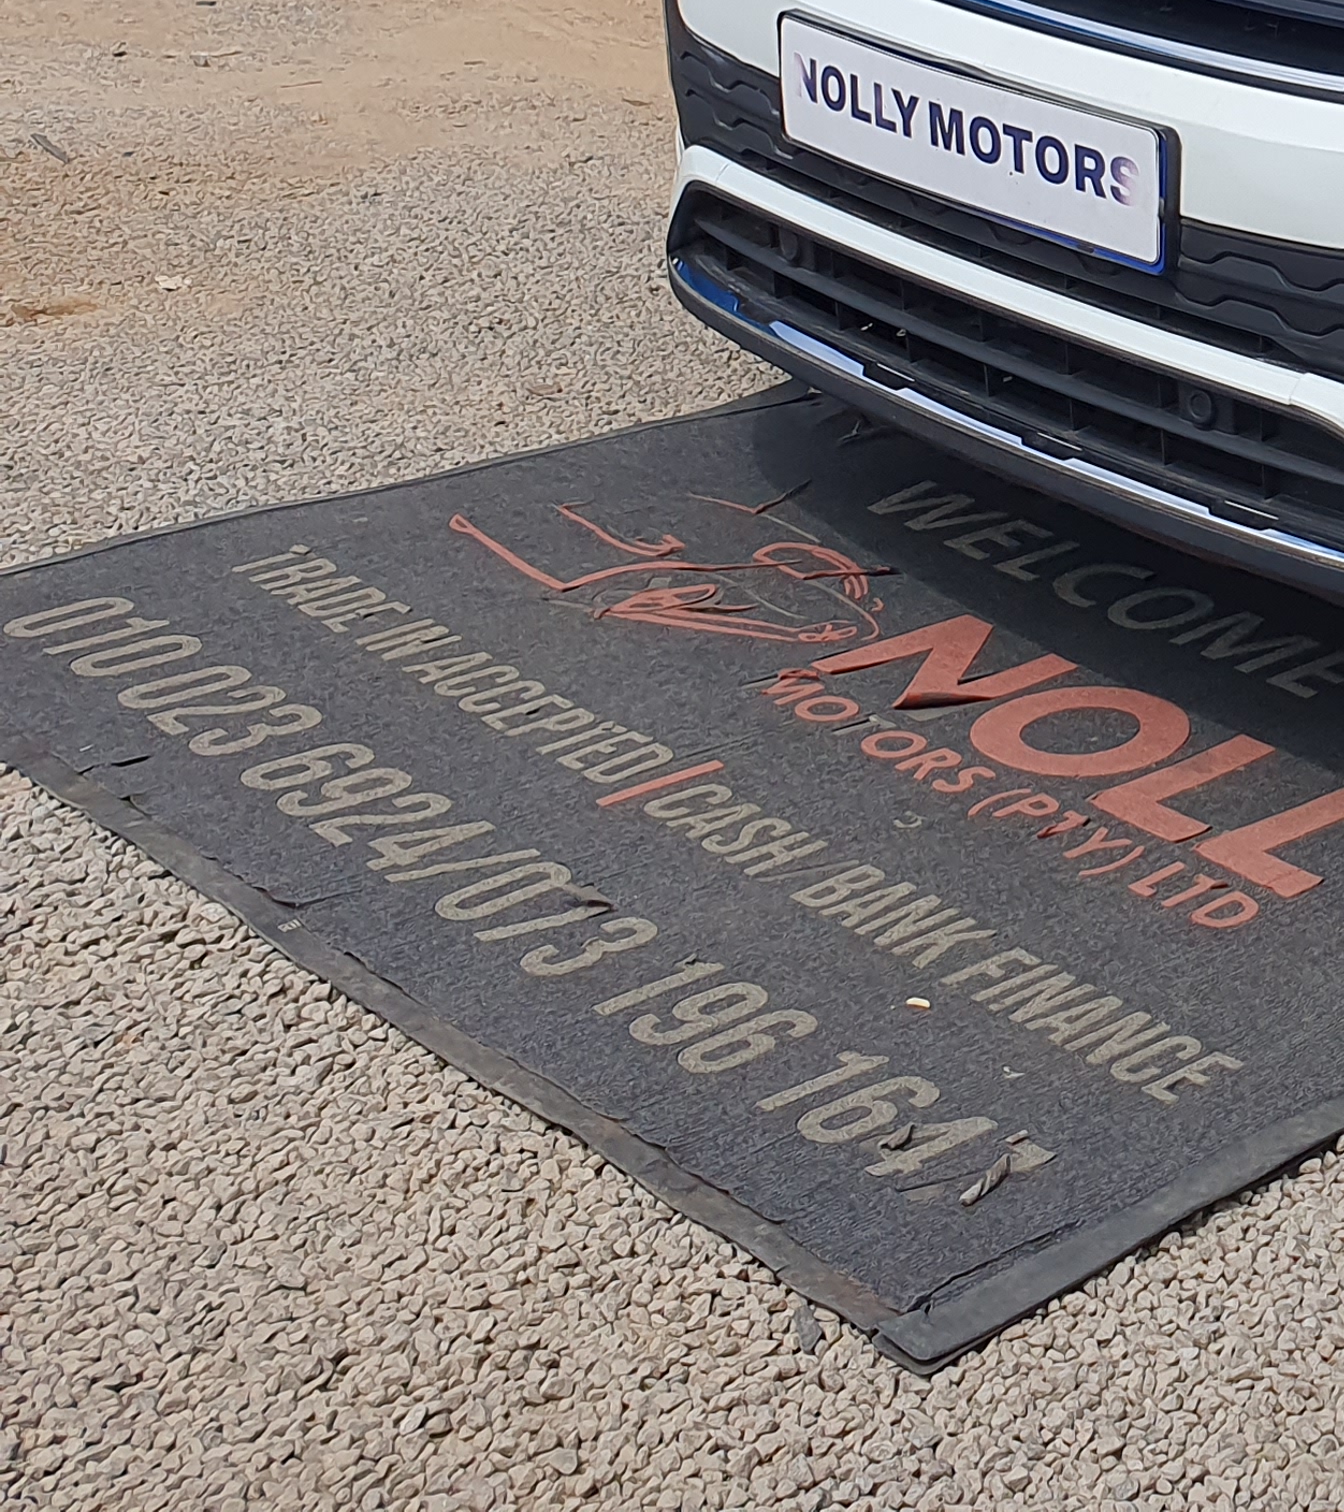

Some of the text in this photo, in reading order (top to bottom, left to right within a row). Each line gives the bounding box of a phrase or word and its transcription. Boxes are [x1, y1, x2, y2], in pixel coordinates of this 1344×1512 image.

[794, 52, 1139, 207] NOLLY MOTORS
[232, 545, 412, 633] TRADE
[354, 618, 463, 661] IN
[402, 651, 674, 783] ACCEPTED
[3, 597, 202, 676] 010
[117, 665, 323, 756] 023
[596, 954, 818, 1074] 196
[761, 668, 996, 793] MOTORS
[1128, 861, 1260, 929] LTD
[940, 947, 1244, 1104] FINANCE
